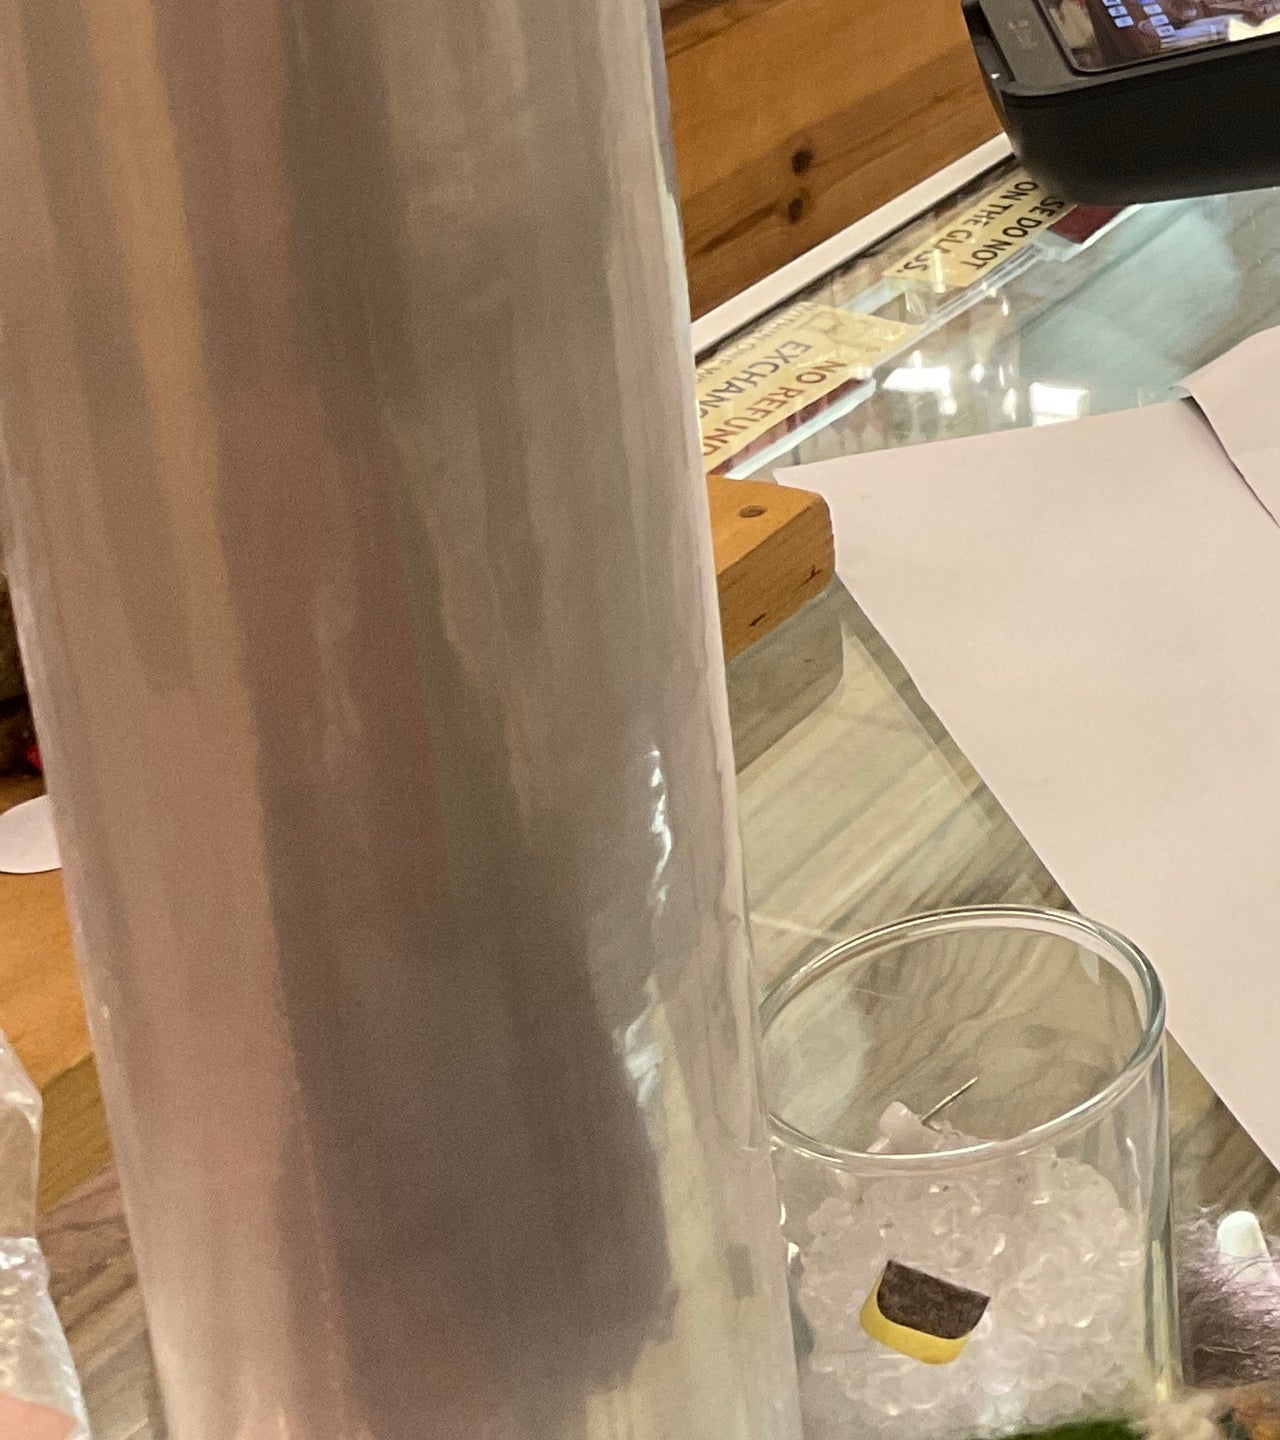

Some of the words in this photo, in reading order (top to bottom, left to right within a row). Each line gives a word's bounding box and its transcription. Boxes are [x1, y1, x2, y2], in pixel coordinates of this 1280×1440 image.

[1000, 181, 1038, 201] ON
[964, 203, 1013, 227] THE
[1003, 216, 1042, 239] DO
[960, 239, 1014, 269] NOT
[796, 358, 849, 386] NO
